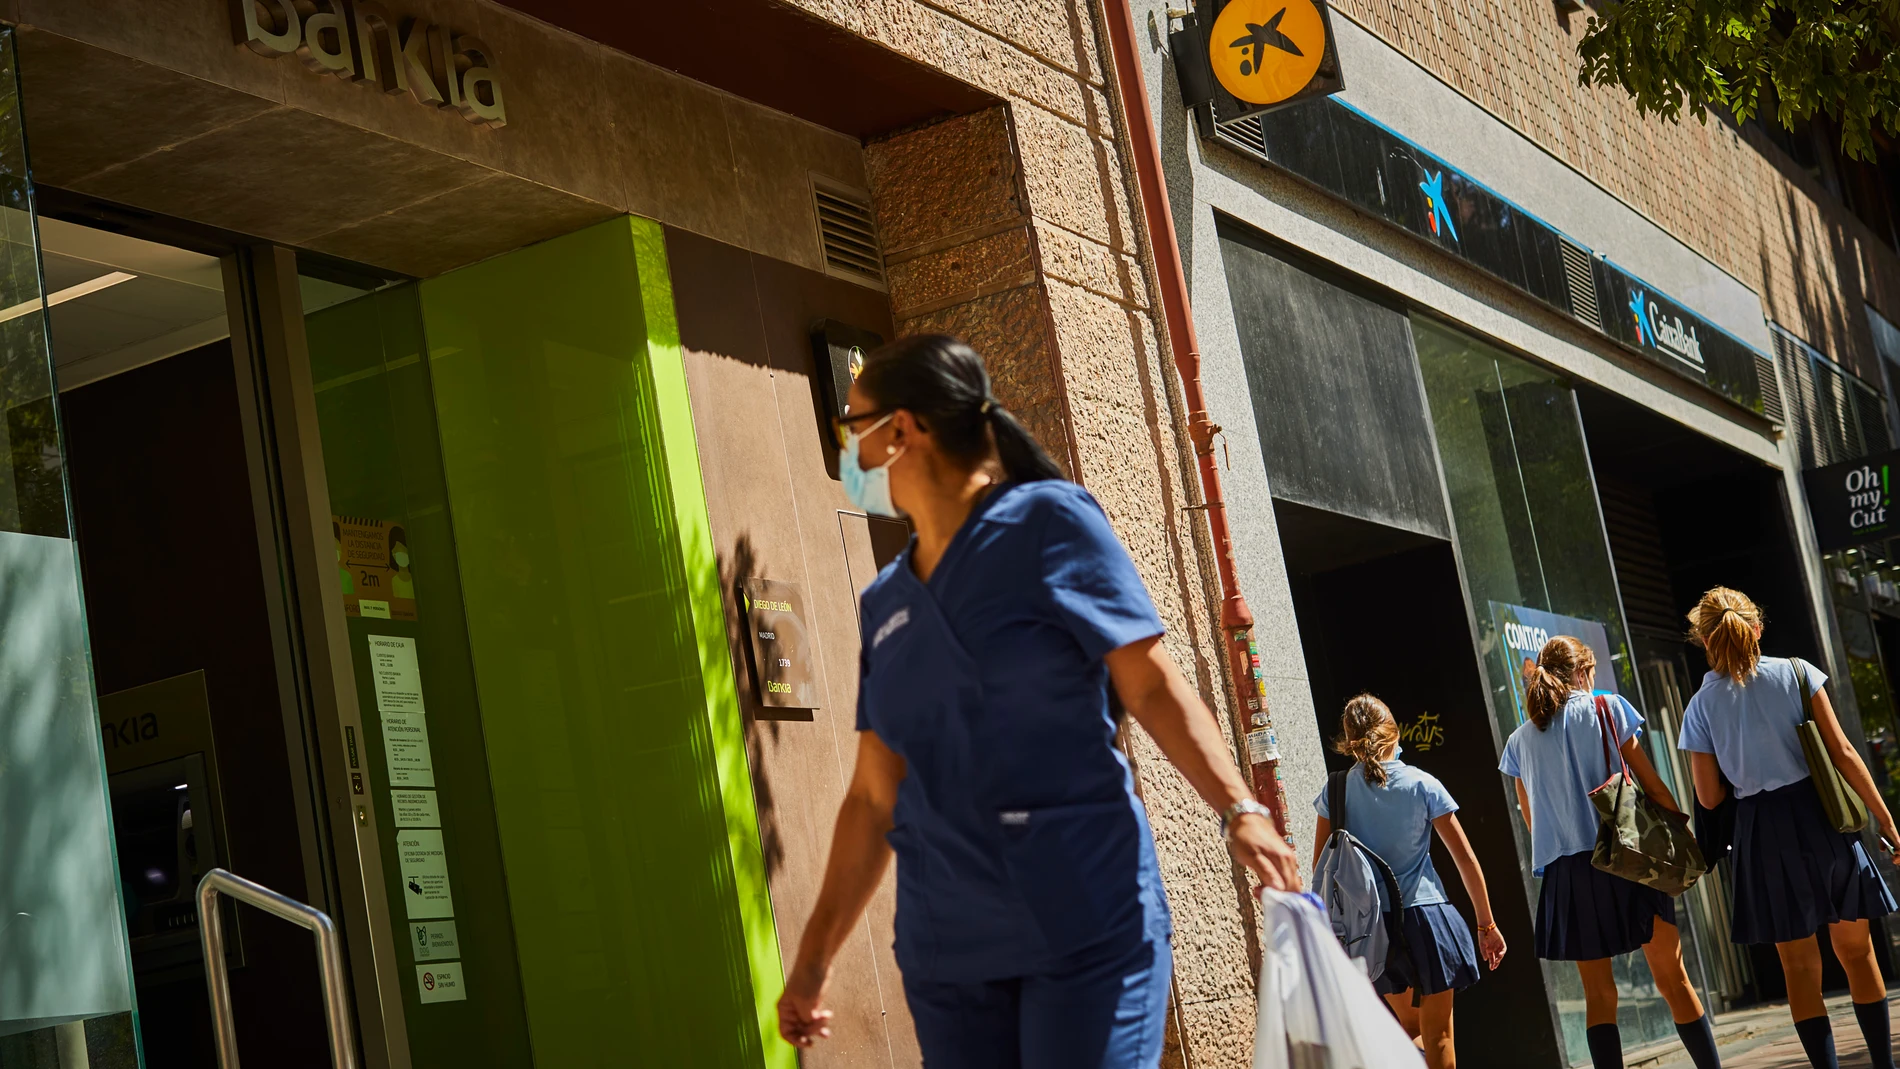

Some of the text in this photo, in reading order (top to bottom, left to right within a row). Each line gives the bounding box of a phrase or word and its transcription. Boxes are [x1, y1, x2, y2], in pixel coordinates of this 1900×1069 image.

[1649, 301, 1704, 364] CaixaBank
[1846, 466, 1880, 492] Oh
[1849, 489, 1881, 510] my
[1850, 506, 1887, 528] Cut
[342, 528, 384, 540] MANTENGAMOS
[348, 540, 382, 550] LA DISTANCIA
[348, 550, 385, 561] DE SEGURIDAD
[360, 570, 380, 587] 2m
[754, 600, 792, 612] DIEGO DE LEÓN
[759, 632, 775, 640] MADRID
[1504, 622, 1549, 652] CONTIGO
[768, 680, 792, 693] Bankia
[101, 712, 160, 748] nkia
